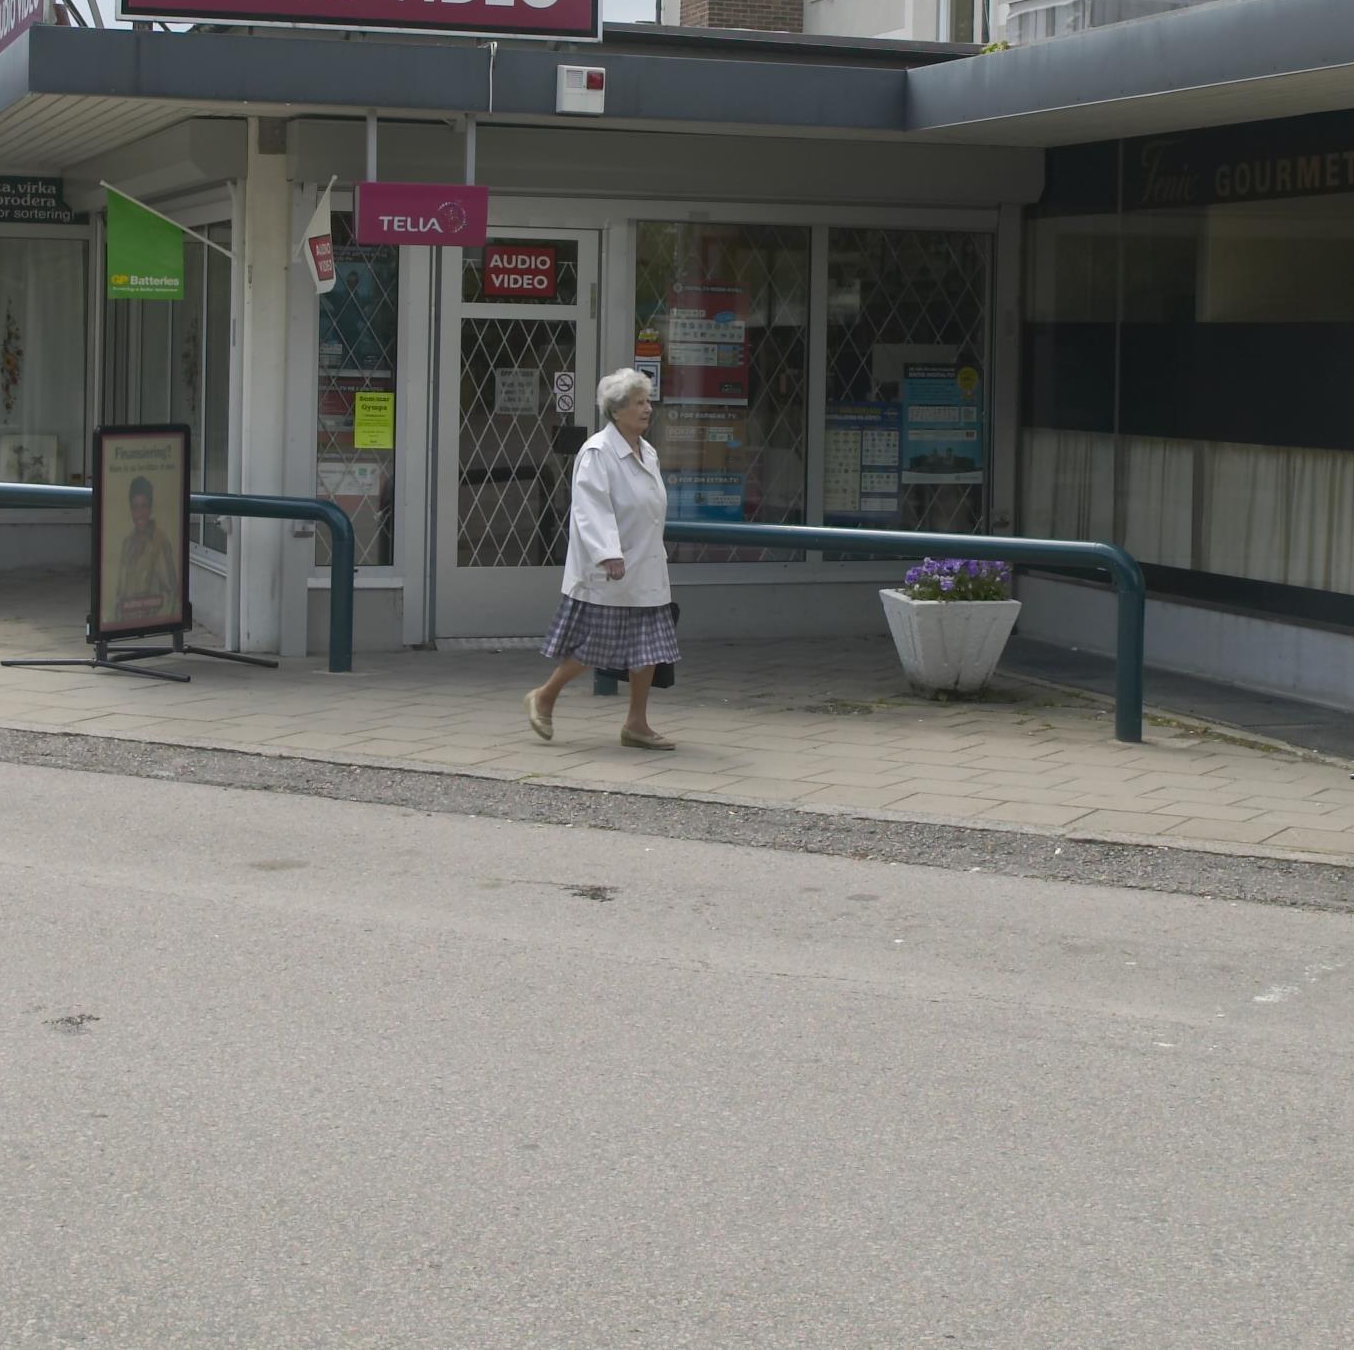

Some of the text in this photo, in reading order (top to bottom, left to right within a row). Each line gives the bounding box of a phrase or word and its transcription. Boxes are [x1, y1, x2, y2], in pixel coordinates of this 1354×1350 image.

[17, 180, 56, 195] virka
[378, 215, 444, 234] TELIA
[489, 253, 551, 270] AUDIO
[130, 274, 180, 287] Batteries
[491, 273, 548, 290] VIDEO
